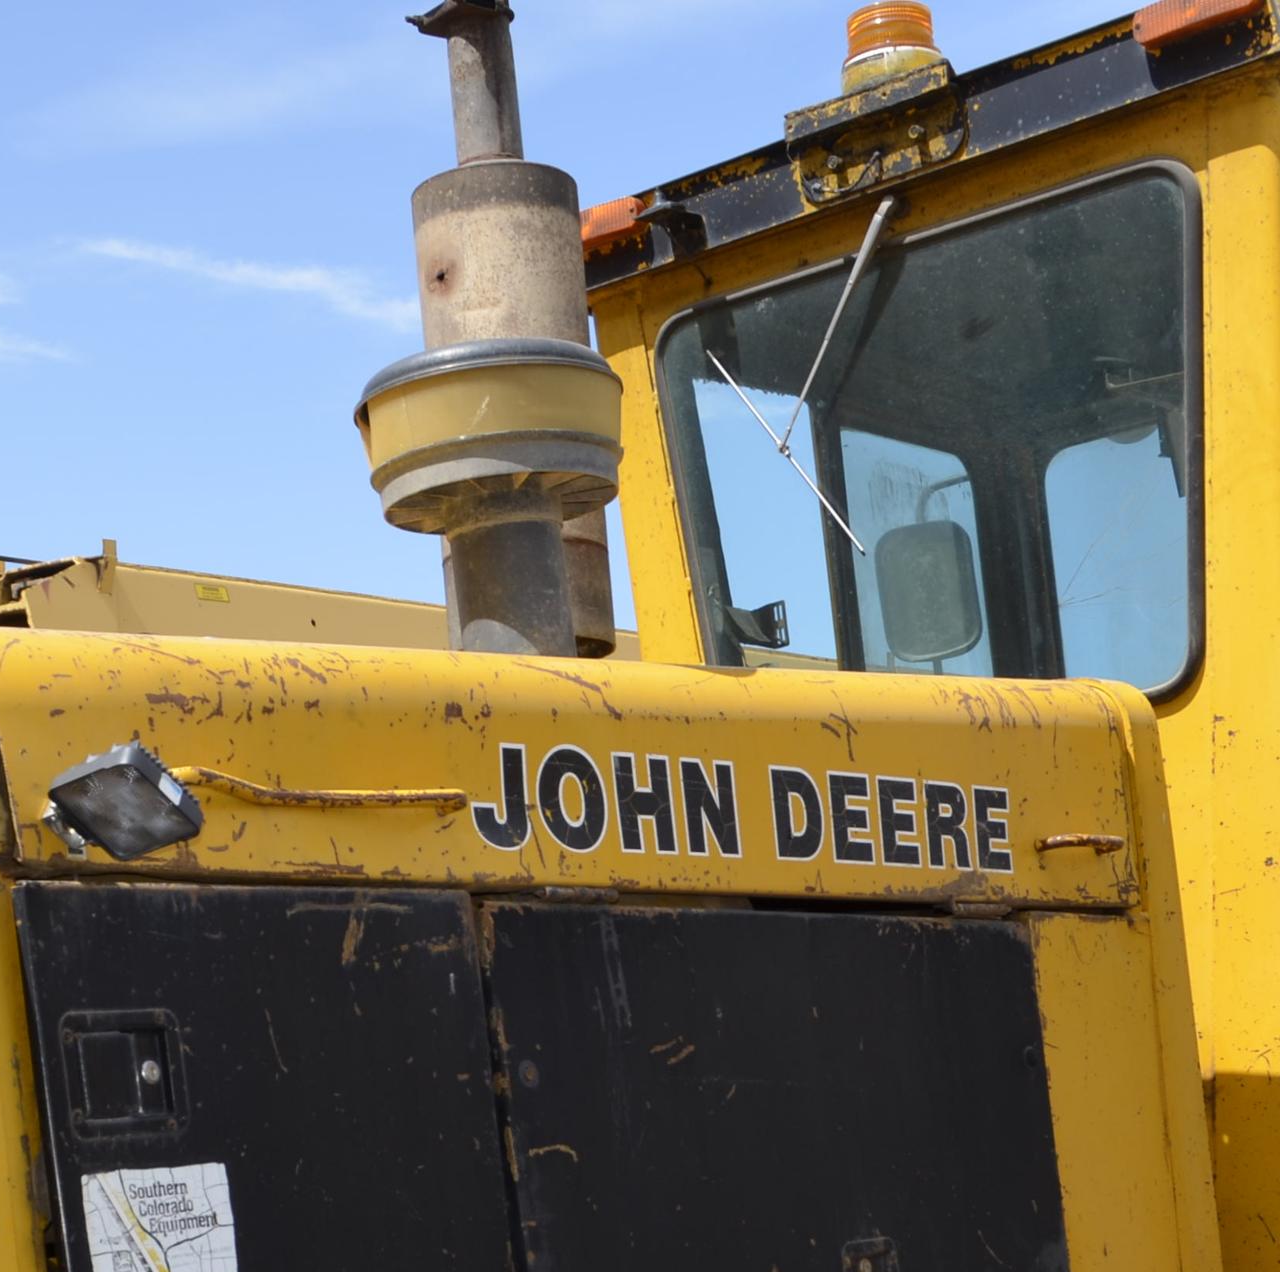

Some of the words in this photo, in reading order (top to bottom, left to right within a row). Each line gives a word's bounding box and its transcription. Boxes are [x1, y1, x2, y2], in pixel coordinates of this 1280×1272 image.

[469, 741, 744, 859] JOHN
[768, 764, 1015, 874] DEERE
[129, 1181, 188, 1200] Southern
[138, 1196, 194, 1217] Colorado
[149, 1211, 218, 1237] Equipment
